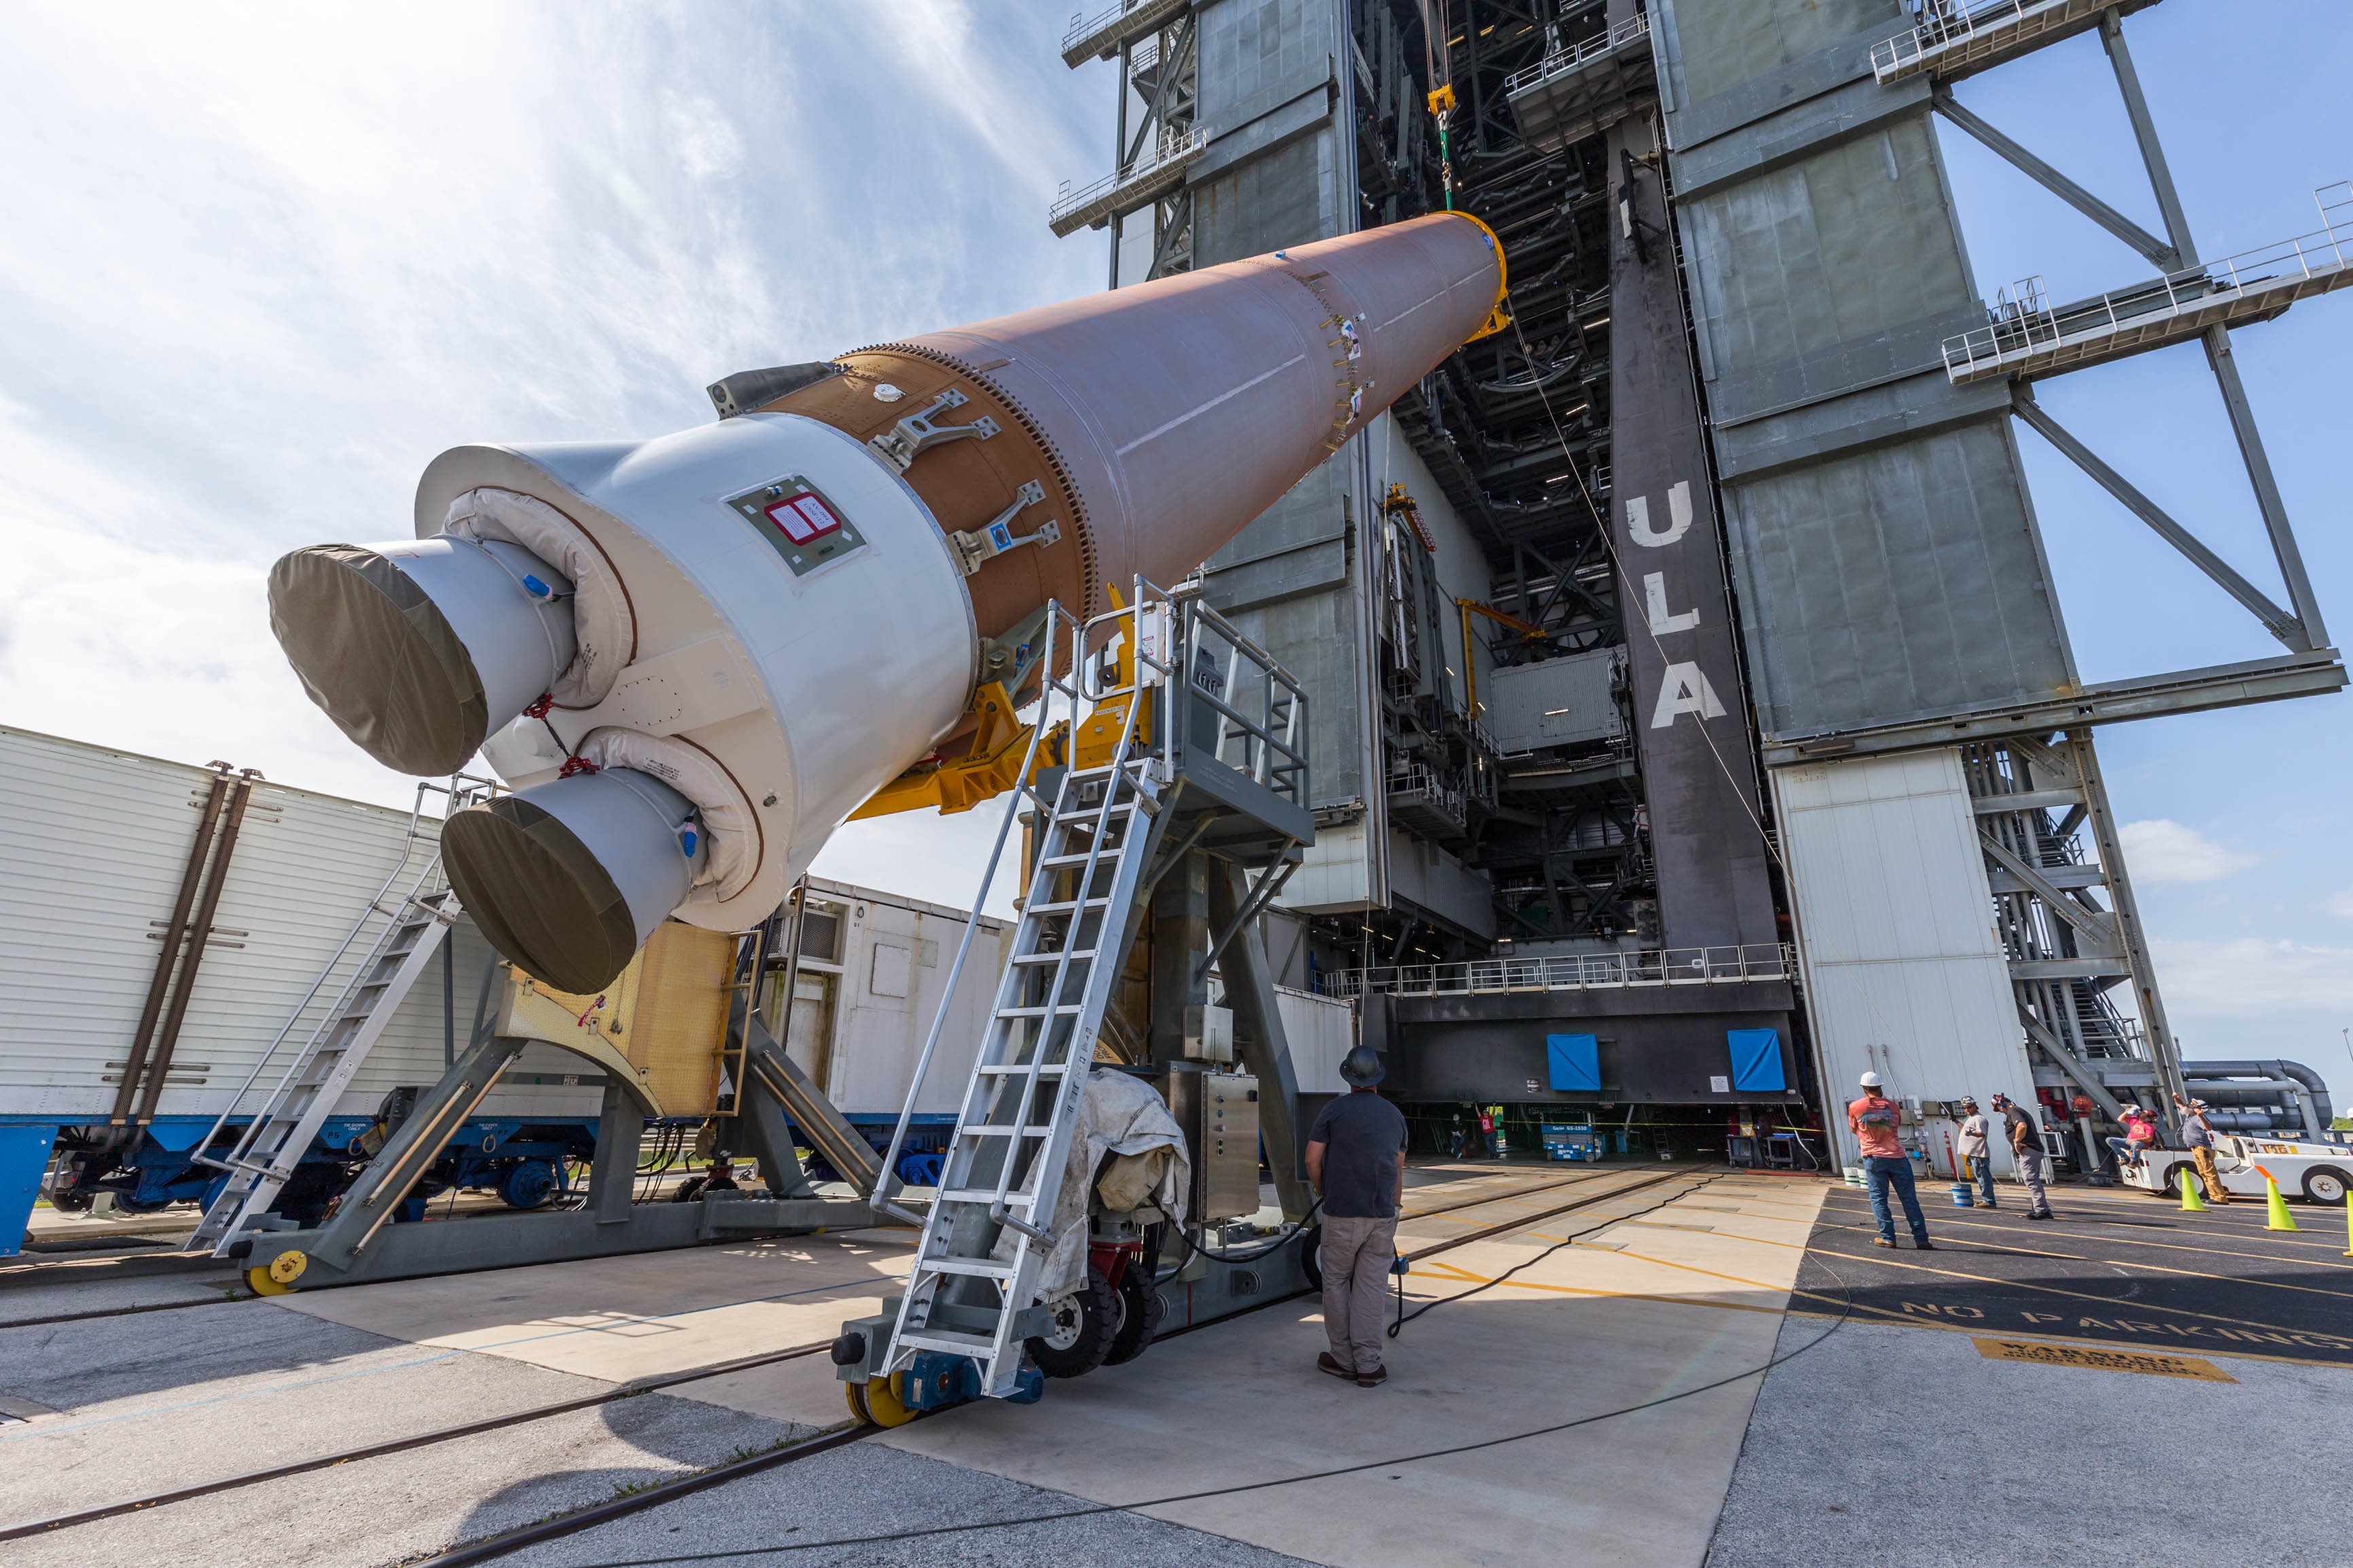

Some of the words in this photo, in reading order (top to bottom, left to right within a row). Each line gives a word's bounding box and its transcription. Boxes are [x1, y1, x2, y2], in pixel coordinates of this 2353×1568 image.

[1625, 480, 1727, 729] ULA
[1901, 1301, 1985, 1319] NO
[2021, 1311, 2352, 1350] PARKING
[1999, 1342, 2185, 1366] WARNING
